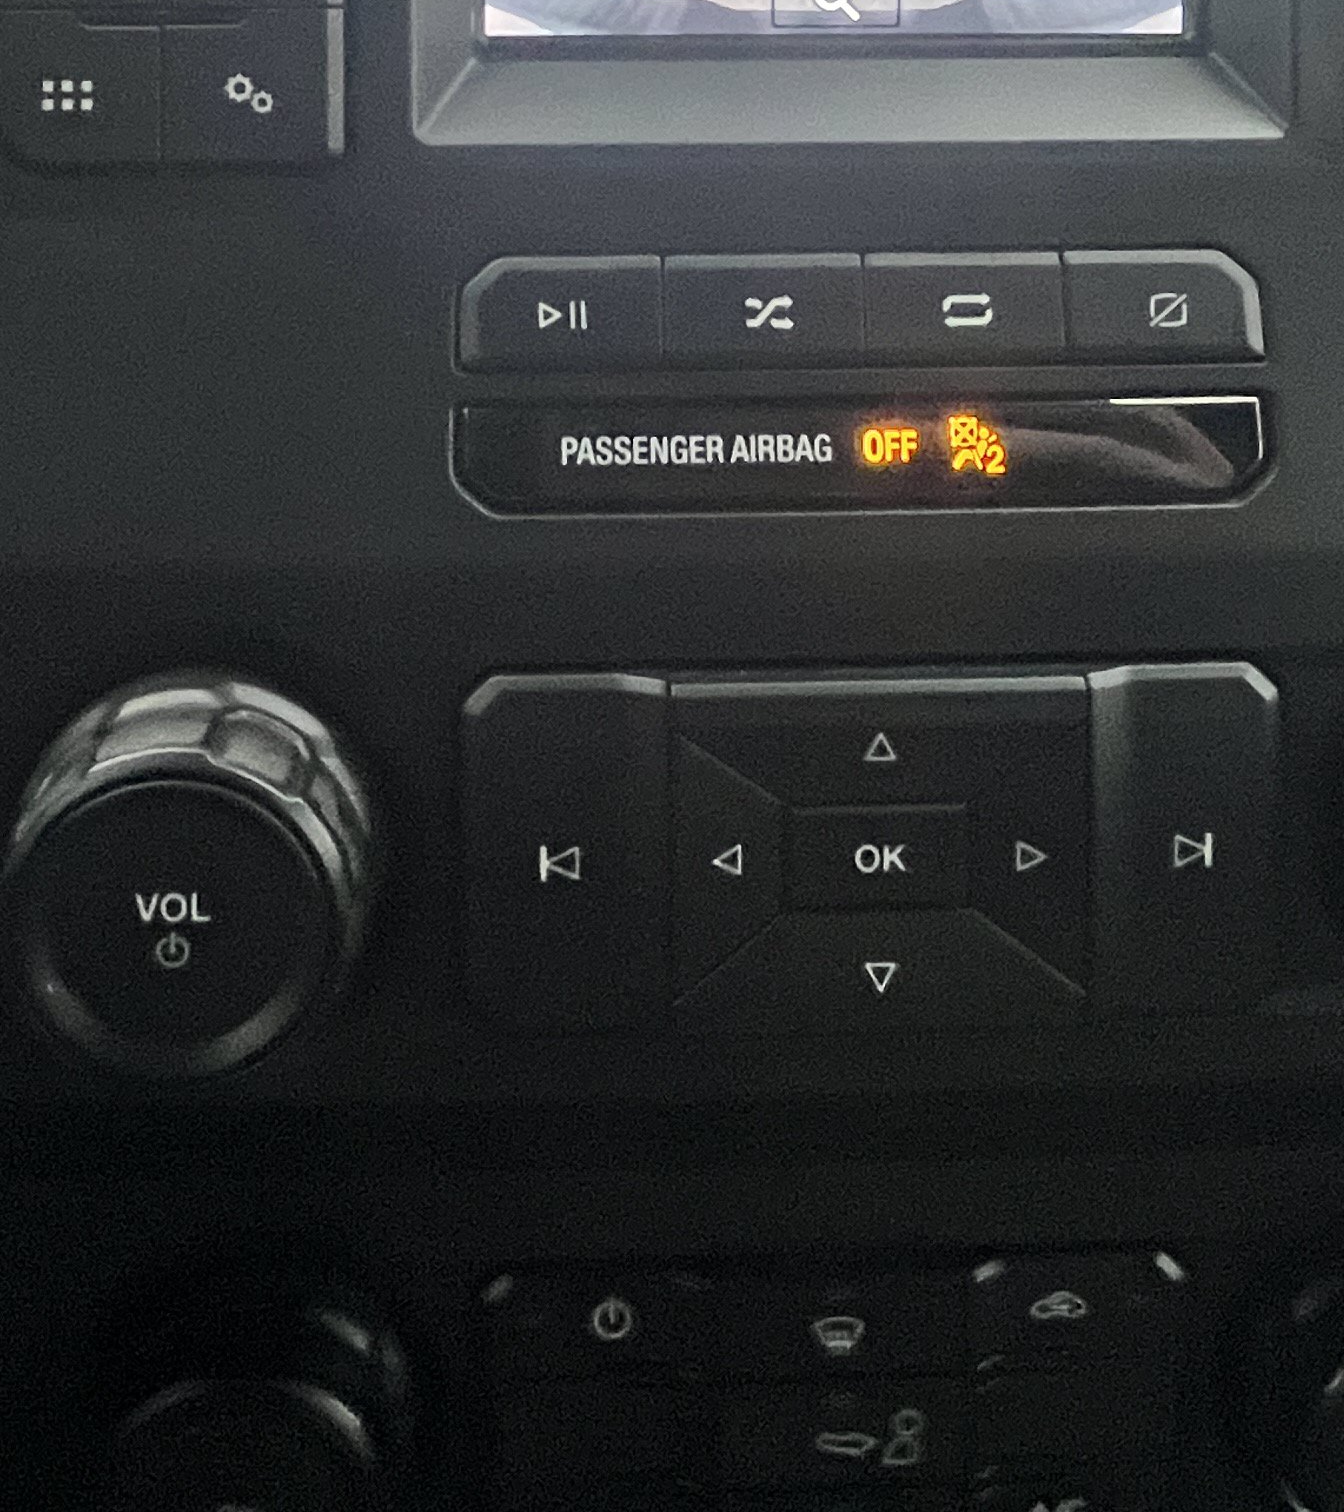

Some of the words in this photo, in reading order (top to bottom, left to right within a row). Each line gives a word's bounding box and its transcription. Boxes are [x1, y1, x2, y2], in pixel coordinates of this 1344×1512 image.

[560, 434, 725, 466] PASSENGER
[730, 433, 833, 464] AIRBAG
[862, 428, 918, 464] OFF
[854, 844, 906, 874] OK
[135, 892, 211, 923] VOL
